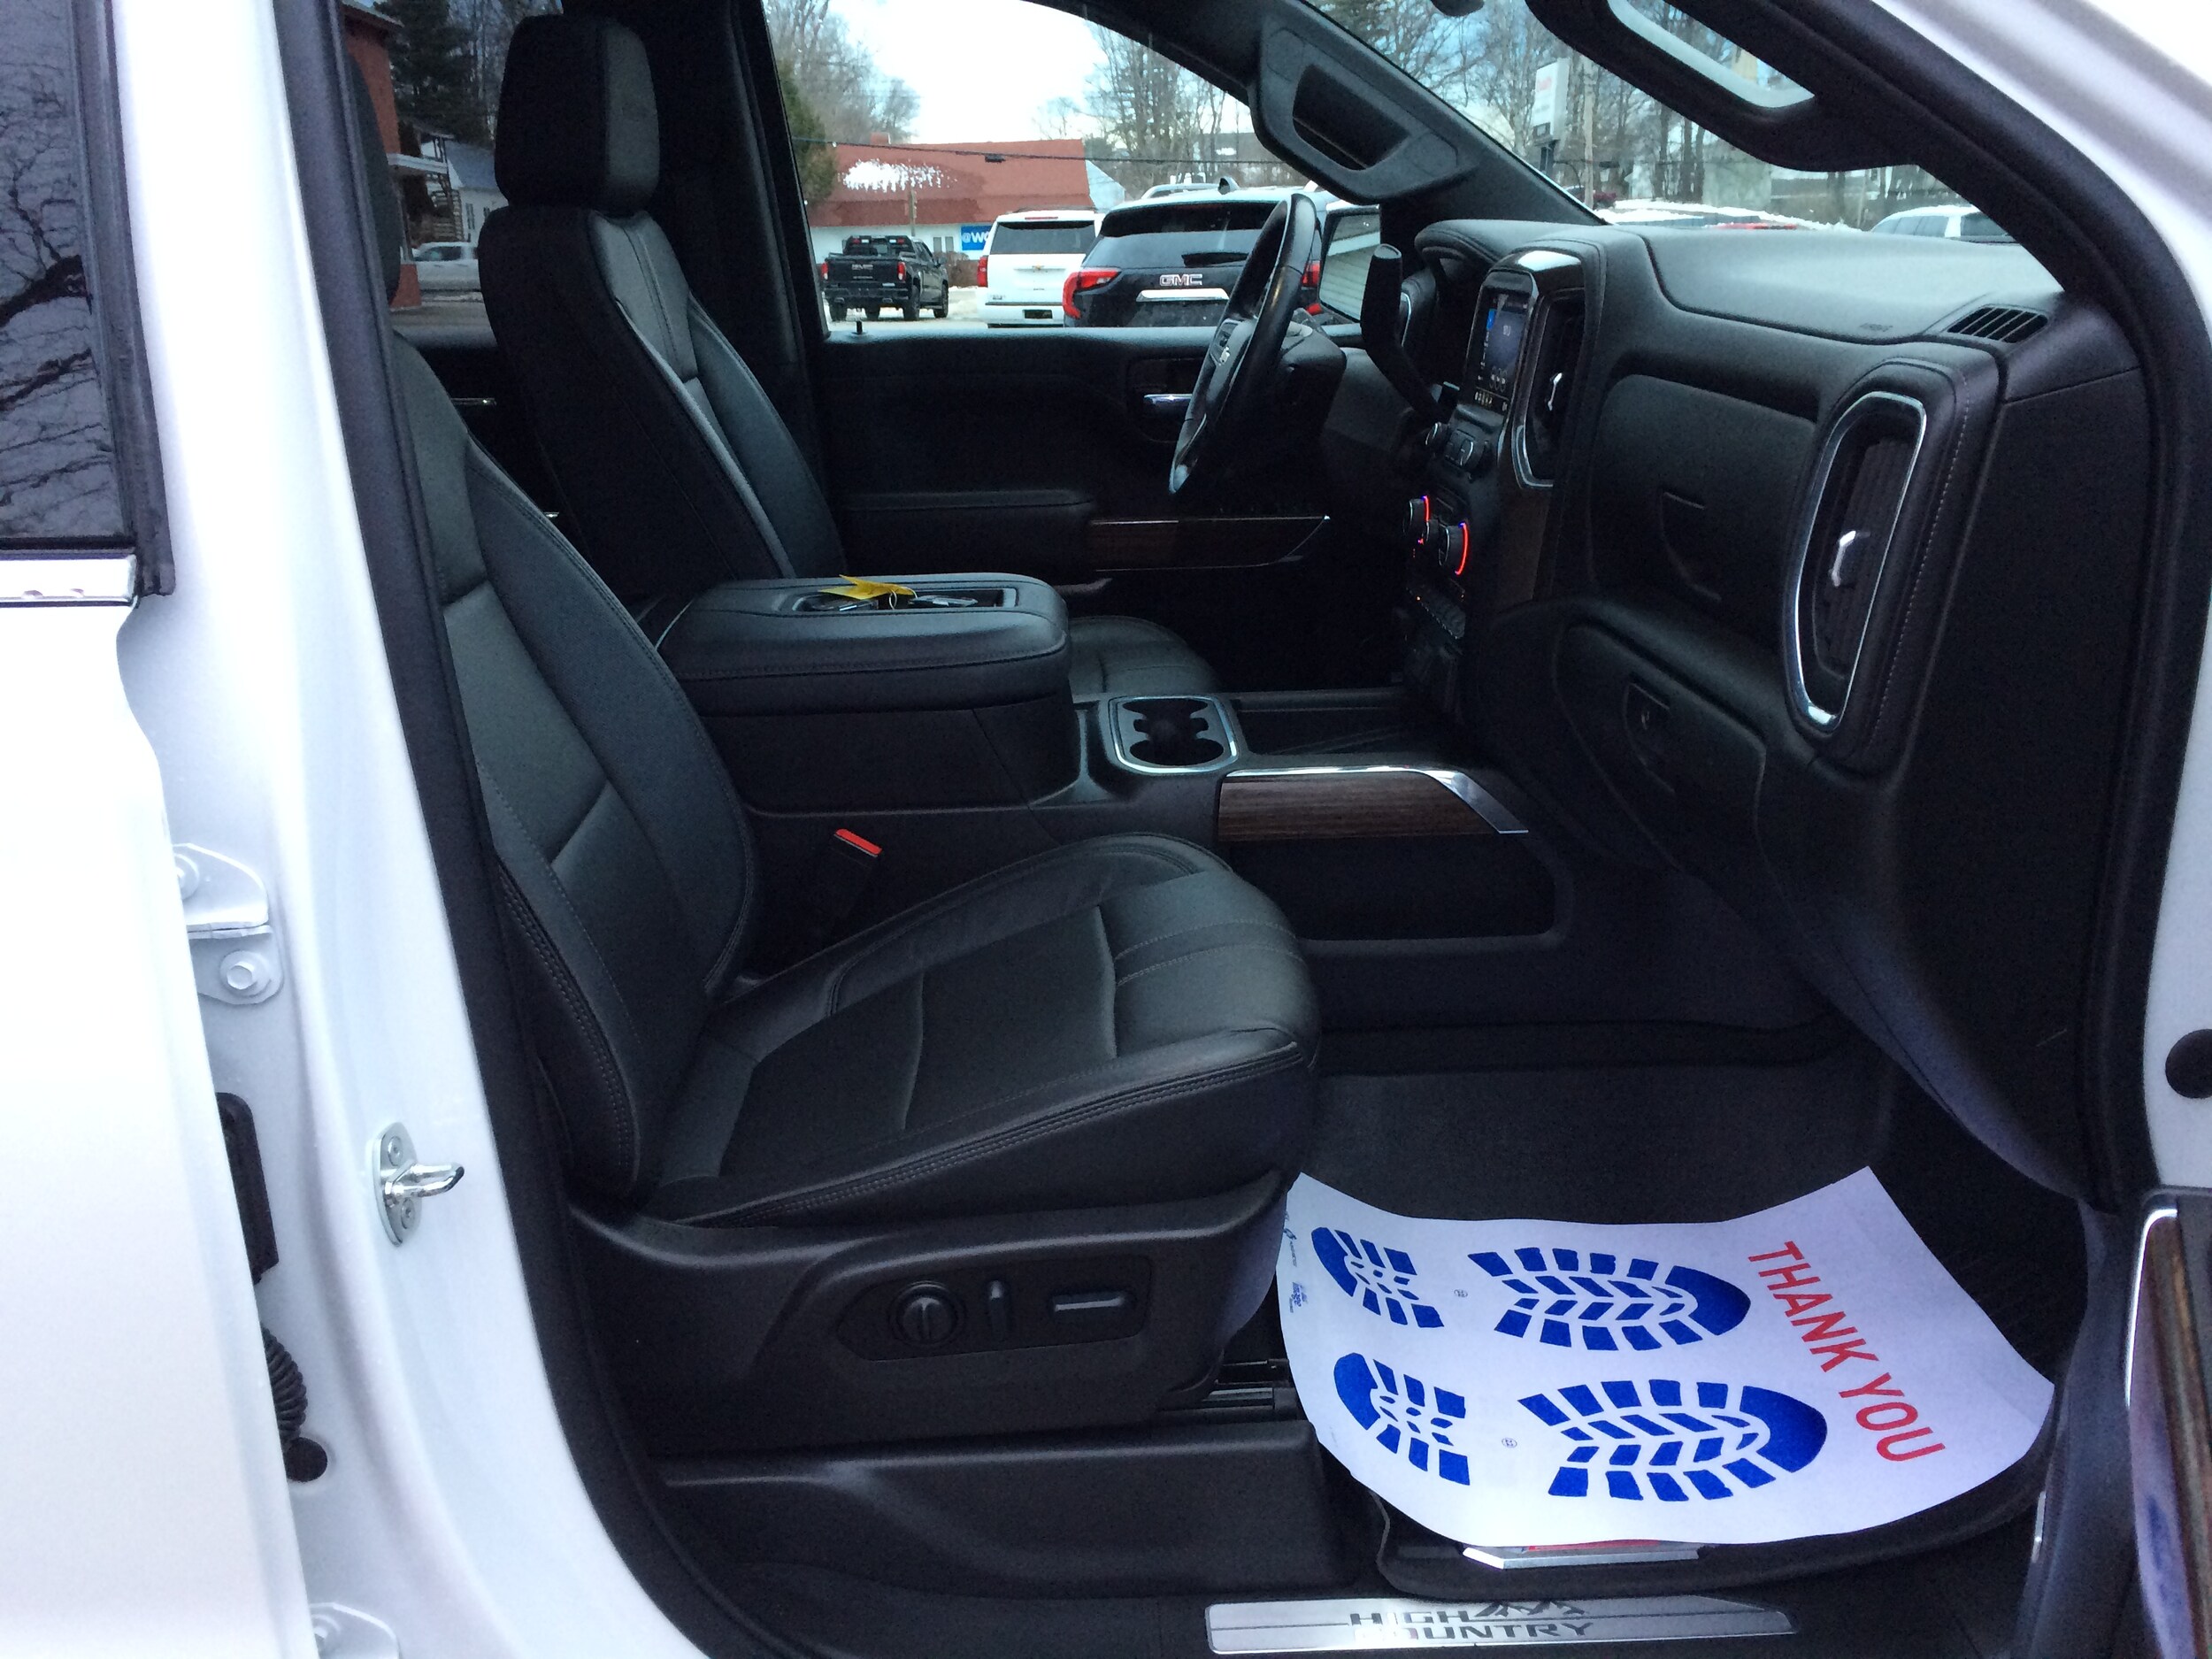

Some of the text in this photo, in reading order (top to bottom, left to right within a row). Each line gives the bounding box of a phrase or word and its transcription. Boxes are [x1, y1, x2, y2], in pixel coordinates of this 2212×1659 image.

[1159, 273, 1203, 287] GMC
[1747, 1240, 1946, 1462] THANK YOU
[1349, 1610, 1470, 1625] HIGH
[1354, 1623, 1592, 1640] UNTRY
